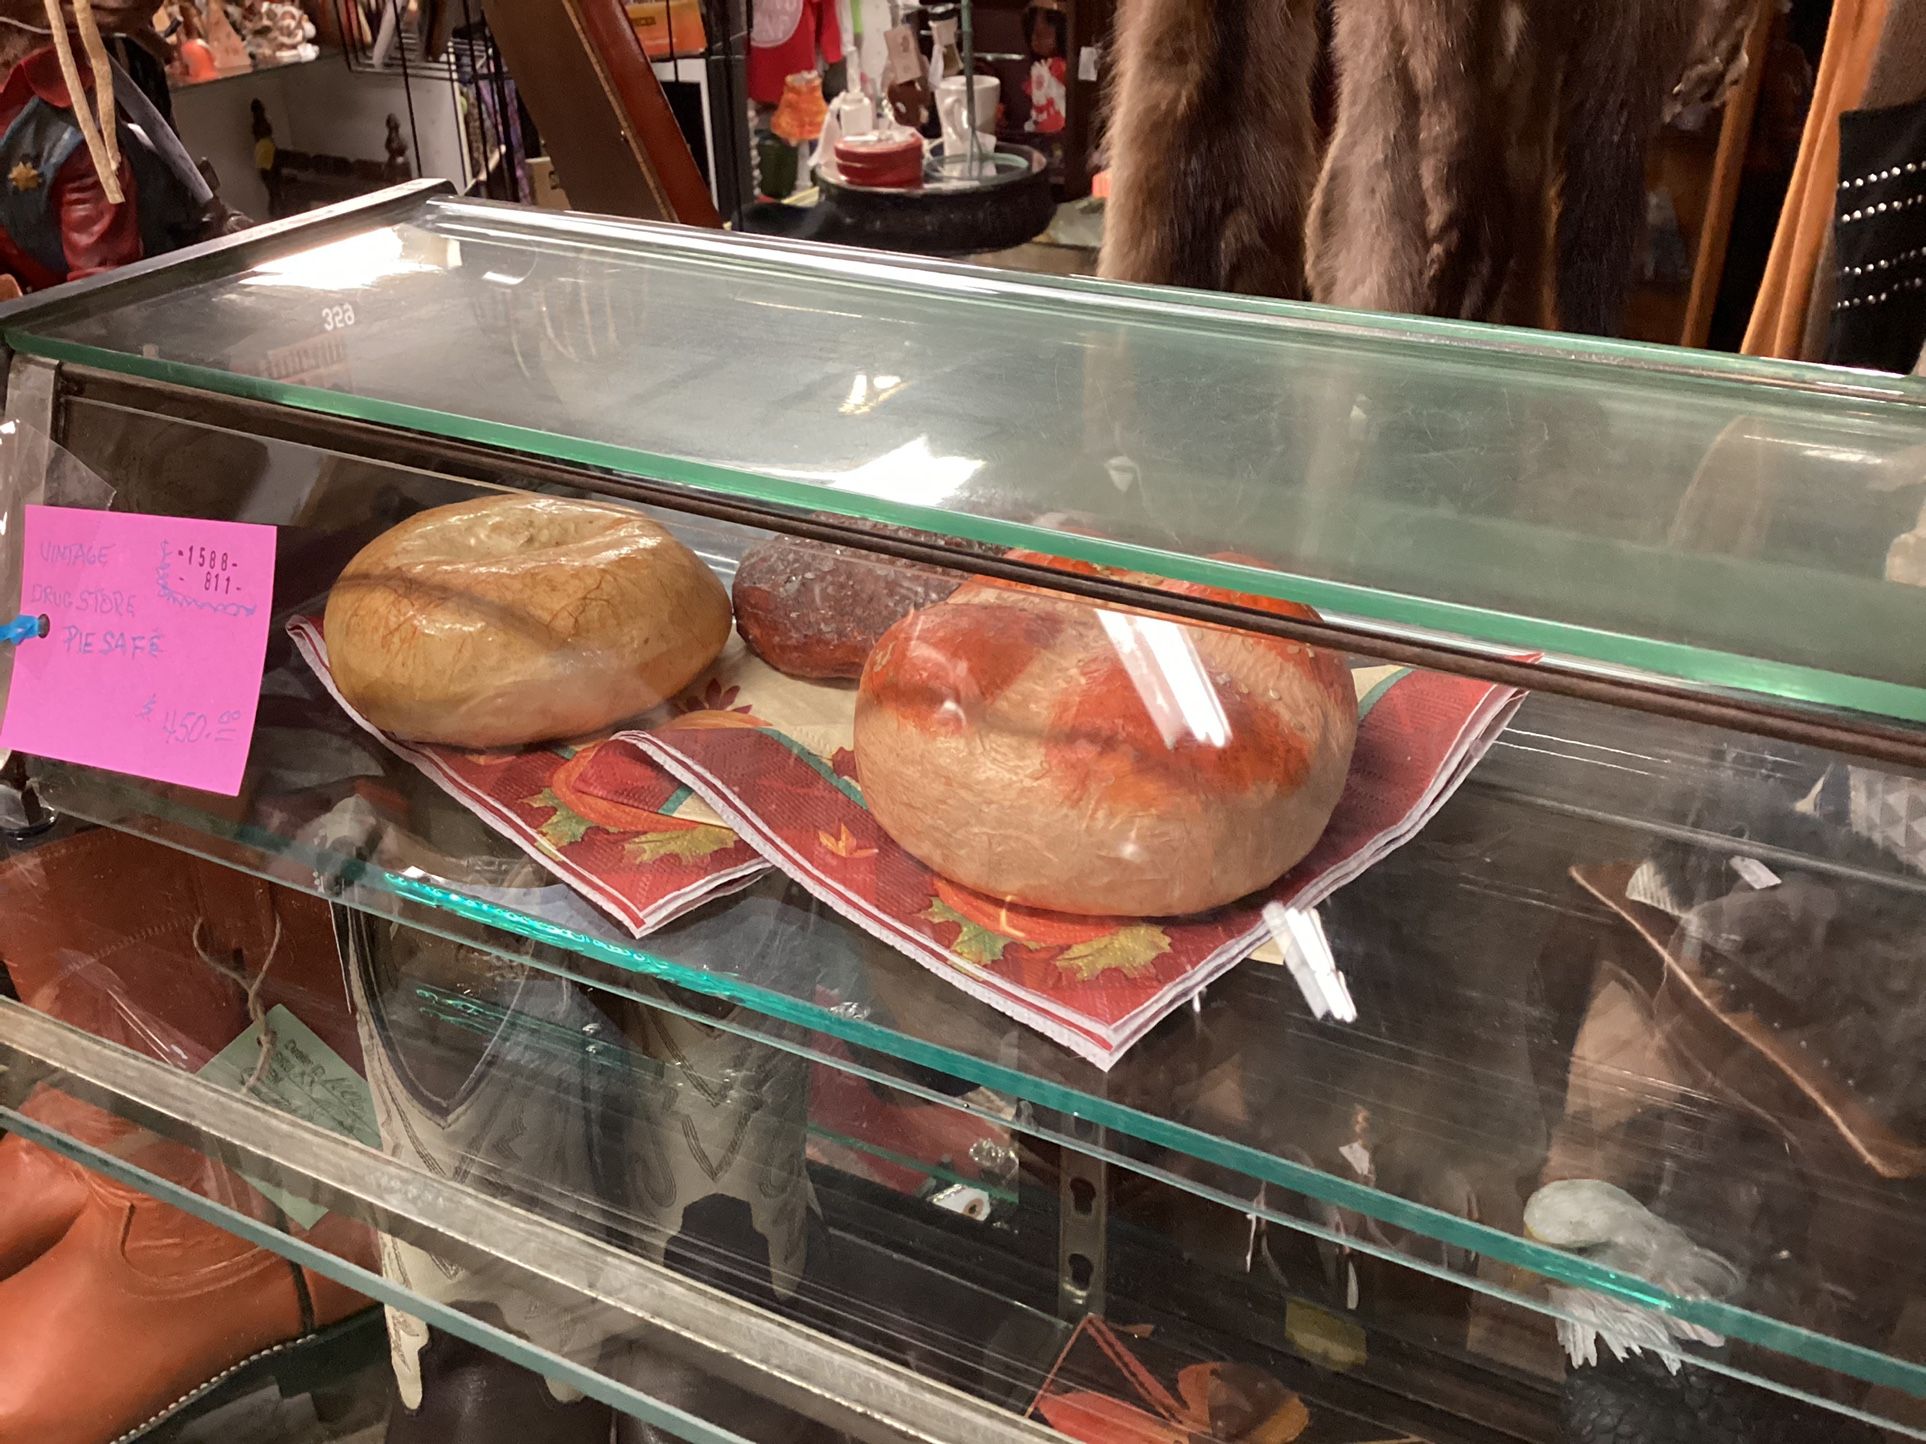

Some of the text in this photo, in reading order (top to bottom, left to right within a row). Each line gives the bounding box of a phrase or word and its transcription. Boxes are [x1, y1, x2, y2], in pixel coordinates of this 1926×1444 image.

[40, 541, 116, 567] VINTAGE
[32, 583, 137, 617] DRUG STORE
[63, 625, 165, 661] PIE SAFE
